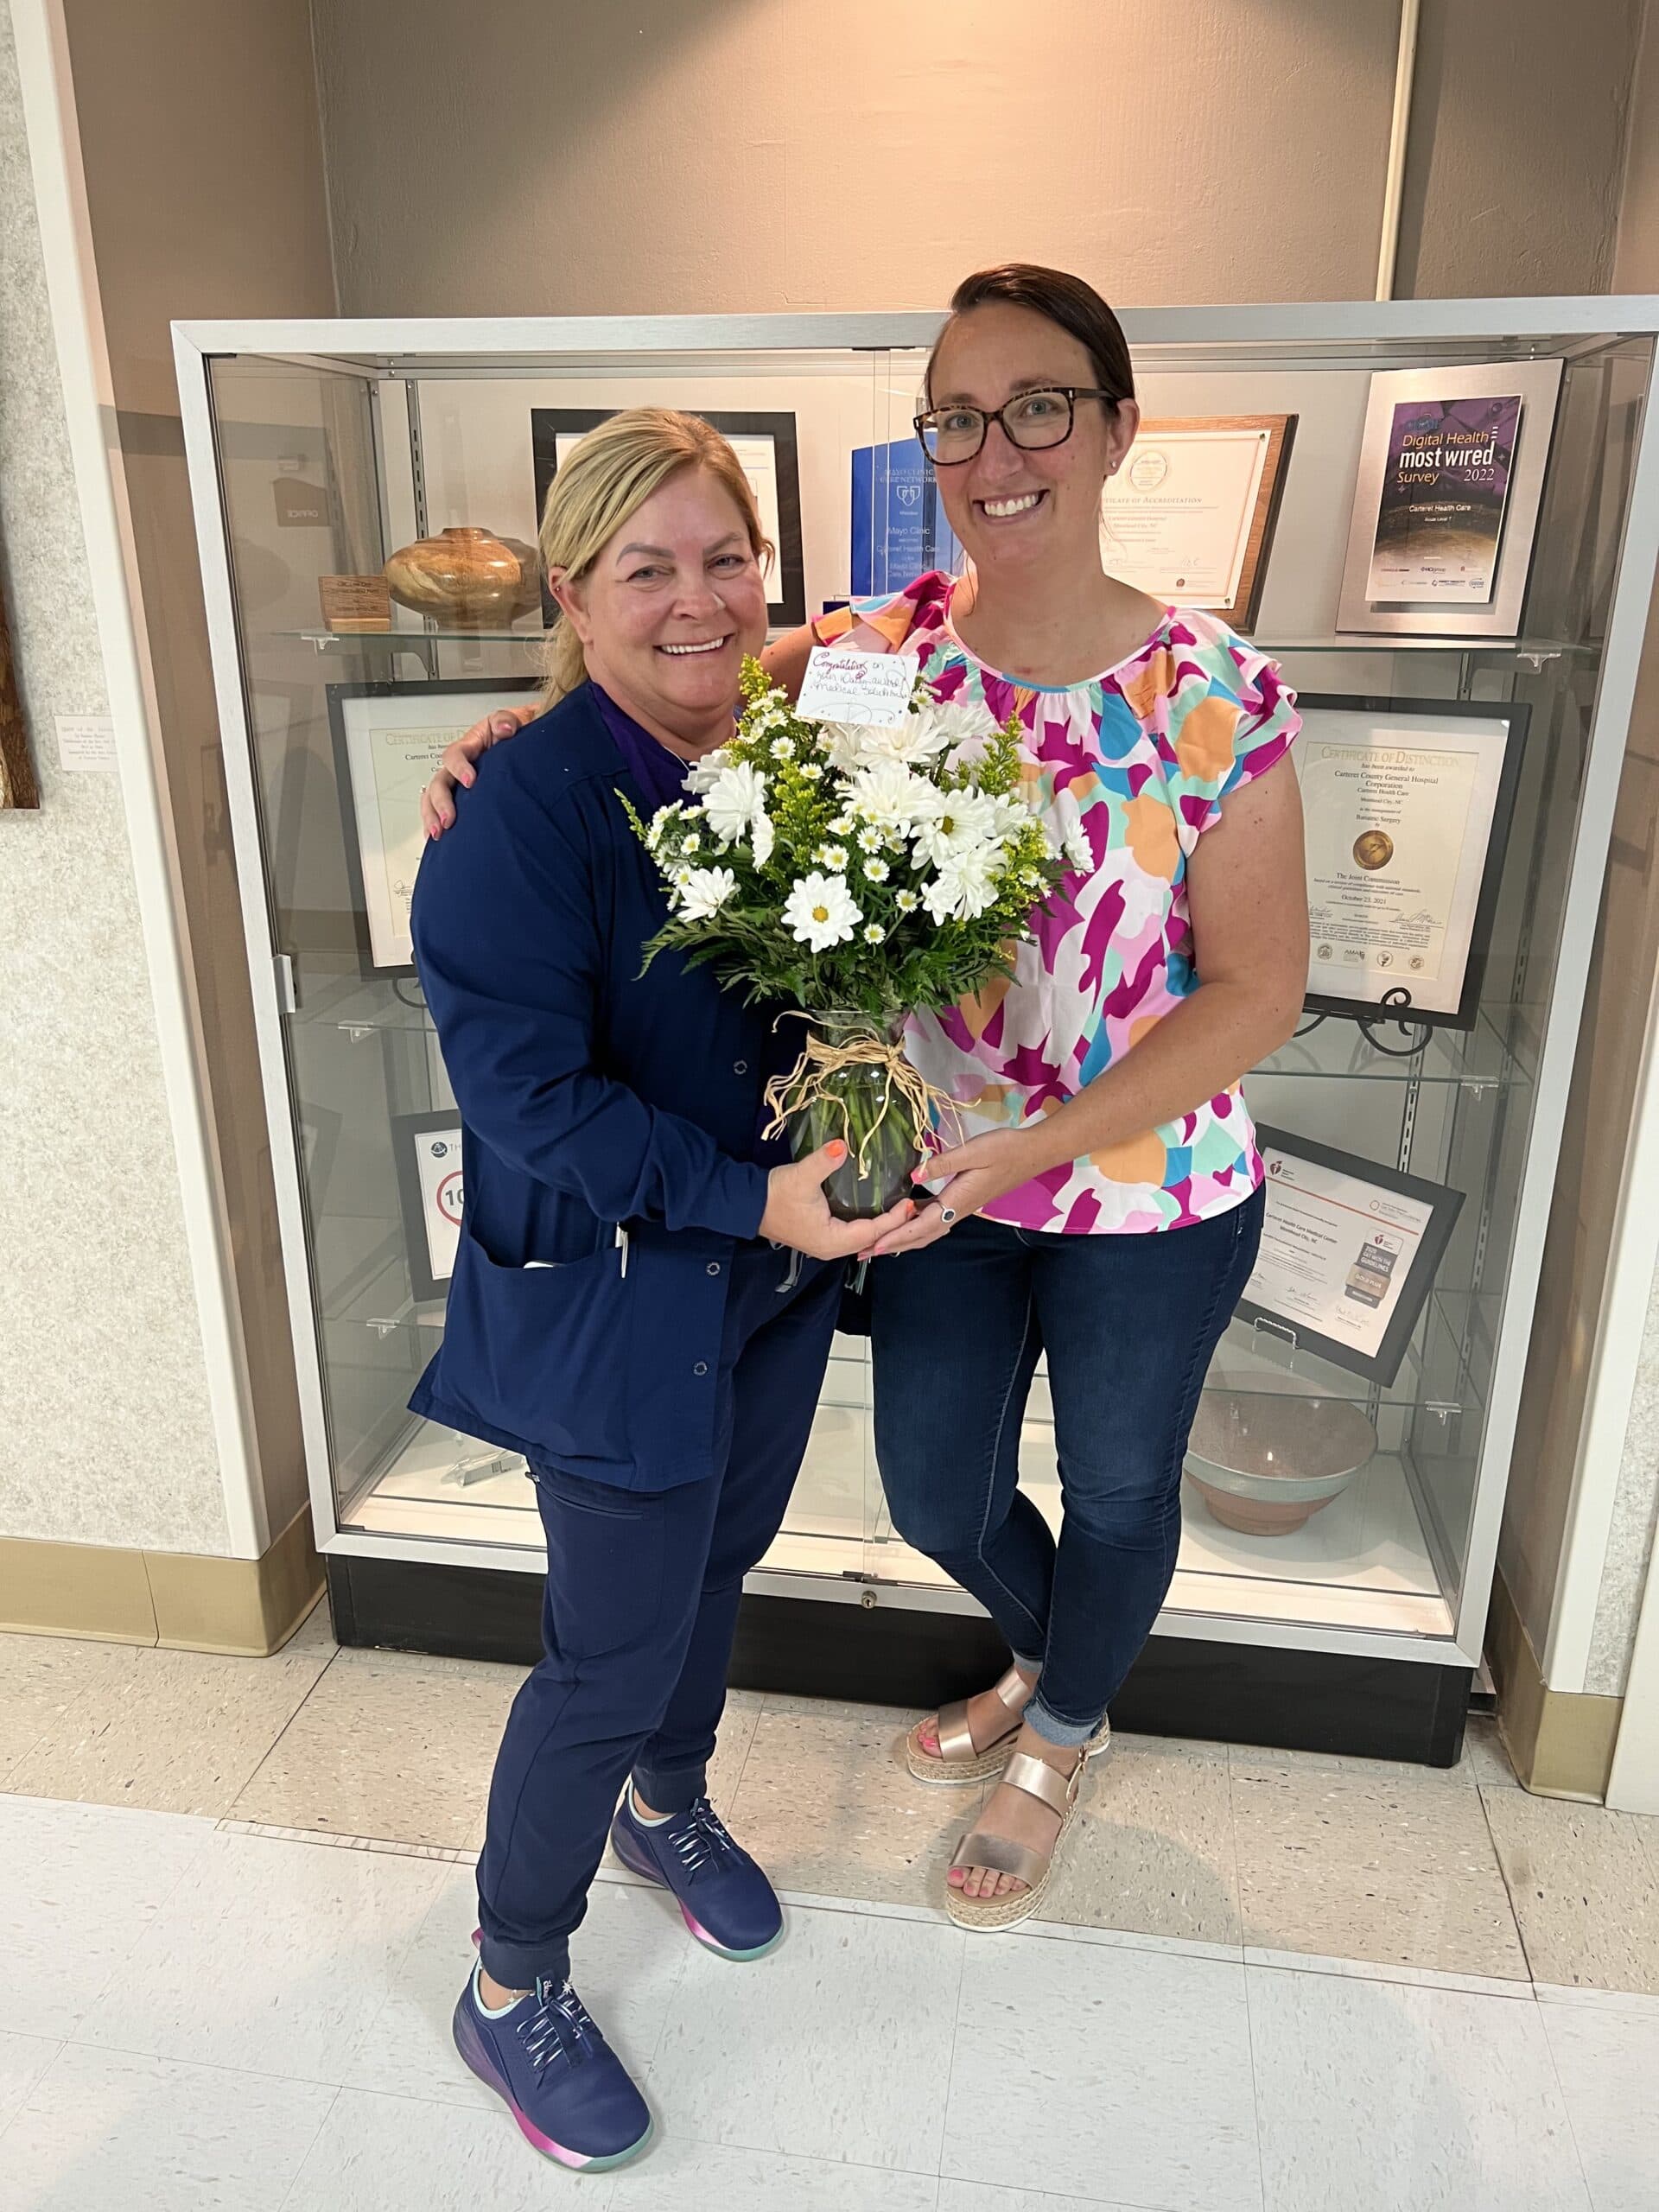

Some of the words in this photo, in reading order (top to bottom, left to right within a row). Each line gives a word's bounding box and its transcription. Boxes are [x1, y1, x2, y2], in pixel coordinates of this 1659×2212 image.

[1402, 433, 1444, 449] Digital
[1446, 431, 1489, 444] Health
[1399, 447, 1442, 467] most
[1445, 440, 1495, 467] wired
[1396, 471, 1440, 485] Survey
[1464, 468, 1495, 481] 2022
[888, 526, 907, 537] Mayo
[910, 526, 931, 535] Clinic
[1321, 746, 1378, 762] CERTIFICATE
[1382, 752, 1395, 763] OF
[1395, 751, 1459, 766] DISTINCTION
[1360, 772, 1384, 780] County
[1384, 773, 1410, 782] General
[1411, 775, 1439, 785] Hospital
[1365, 780, 1403, 789] Corporation
